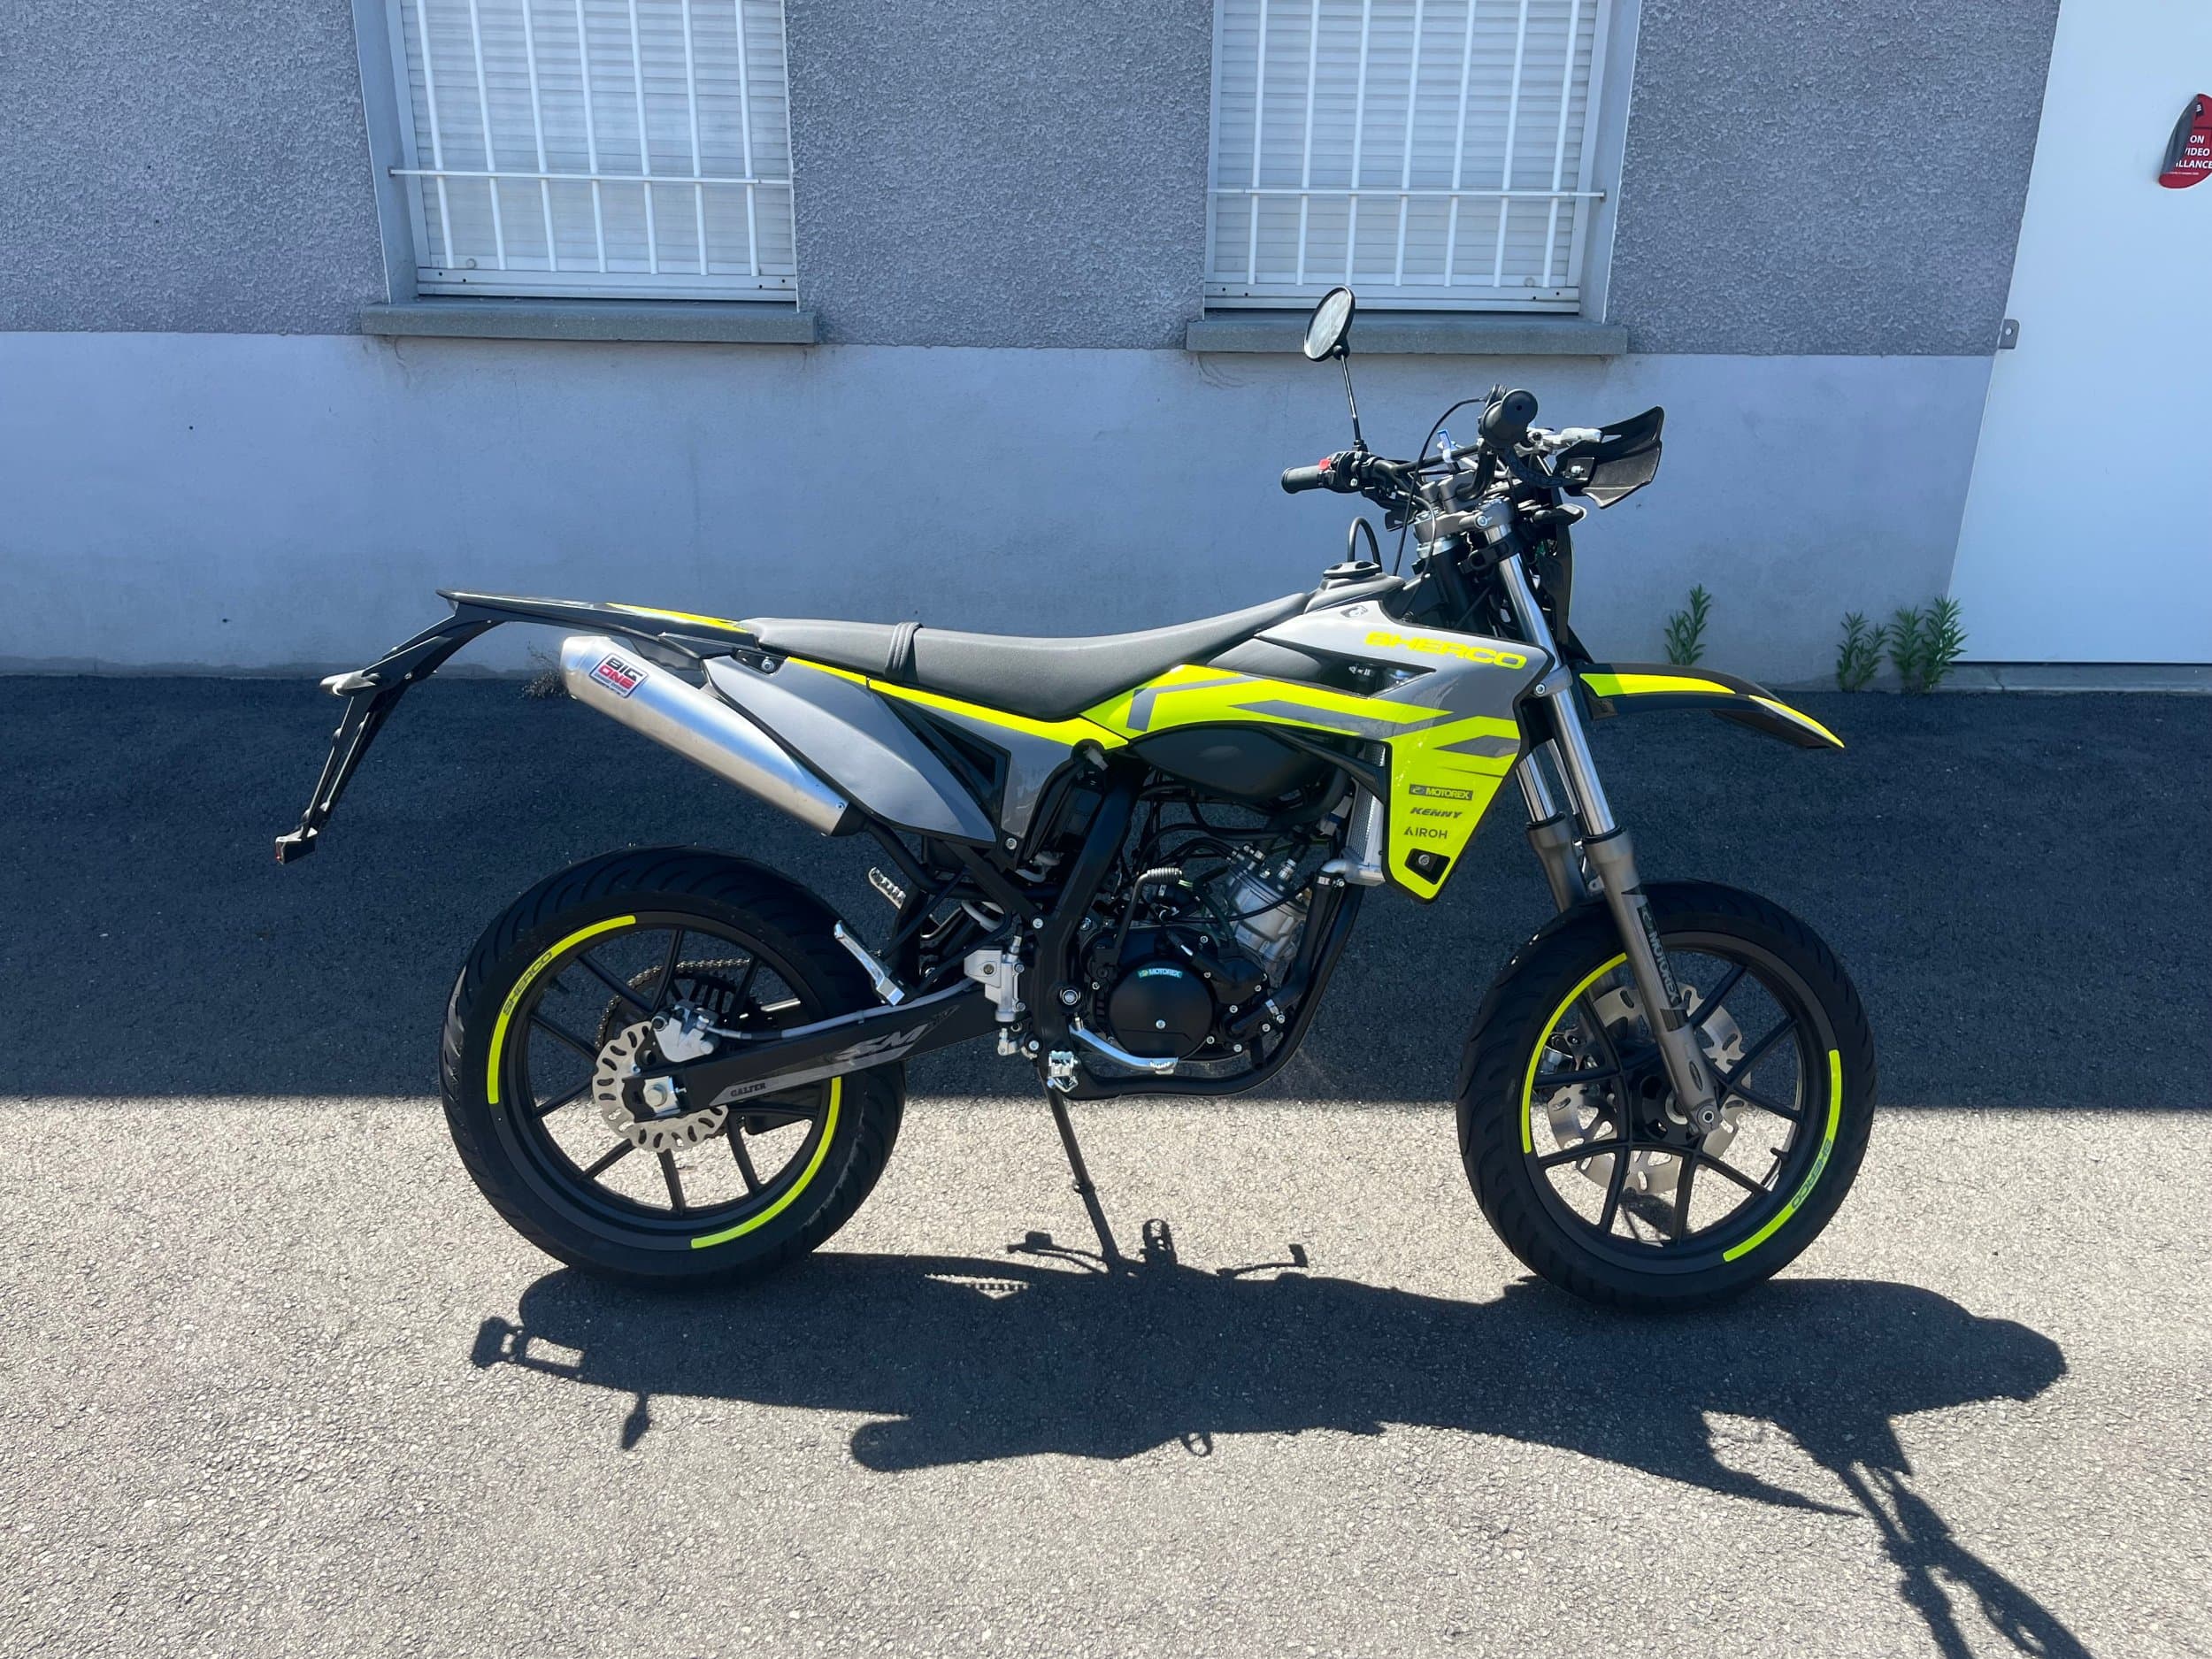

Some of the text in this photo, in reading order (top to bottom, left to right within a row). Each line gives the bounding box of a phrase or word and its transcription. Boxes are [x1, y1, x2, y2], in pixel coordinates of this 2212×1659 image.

[1364, 631, 1527, 670] SHERCO
[598, 664, 635, 690] ONE
[606, 657, 643, 682] BIG
[1425, 787, 1472, 800] MOTOREX
[1409, 807, 1463, 818] KENNY
[1403, 826, 1448, 839] AIROH
[1648, 930, 1680, 1005] MOTOREX
[503, 950, 553, 1017] SHERCO
[1791, 1139, 1833, 1210] SHERCO
